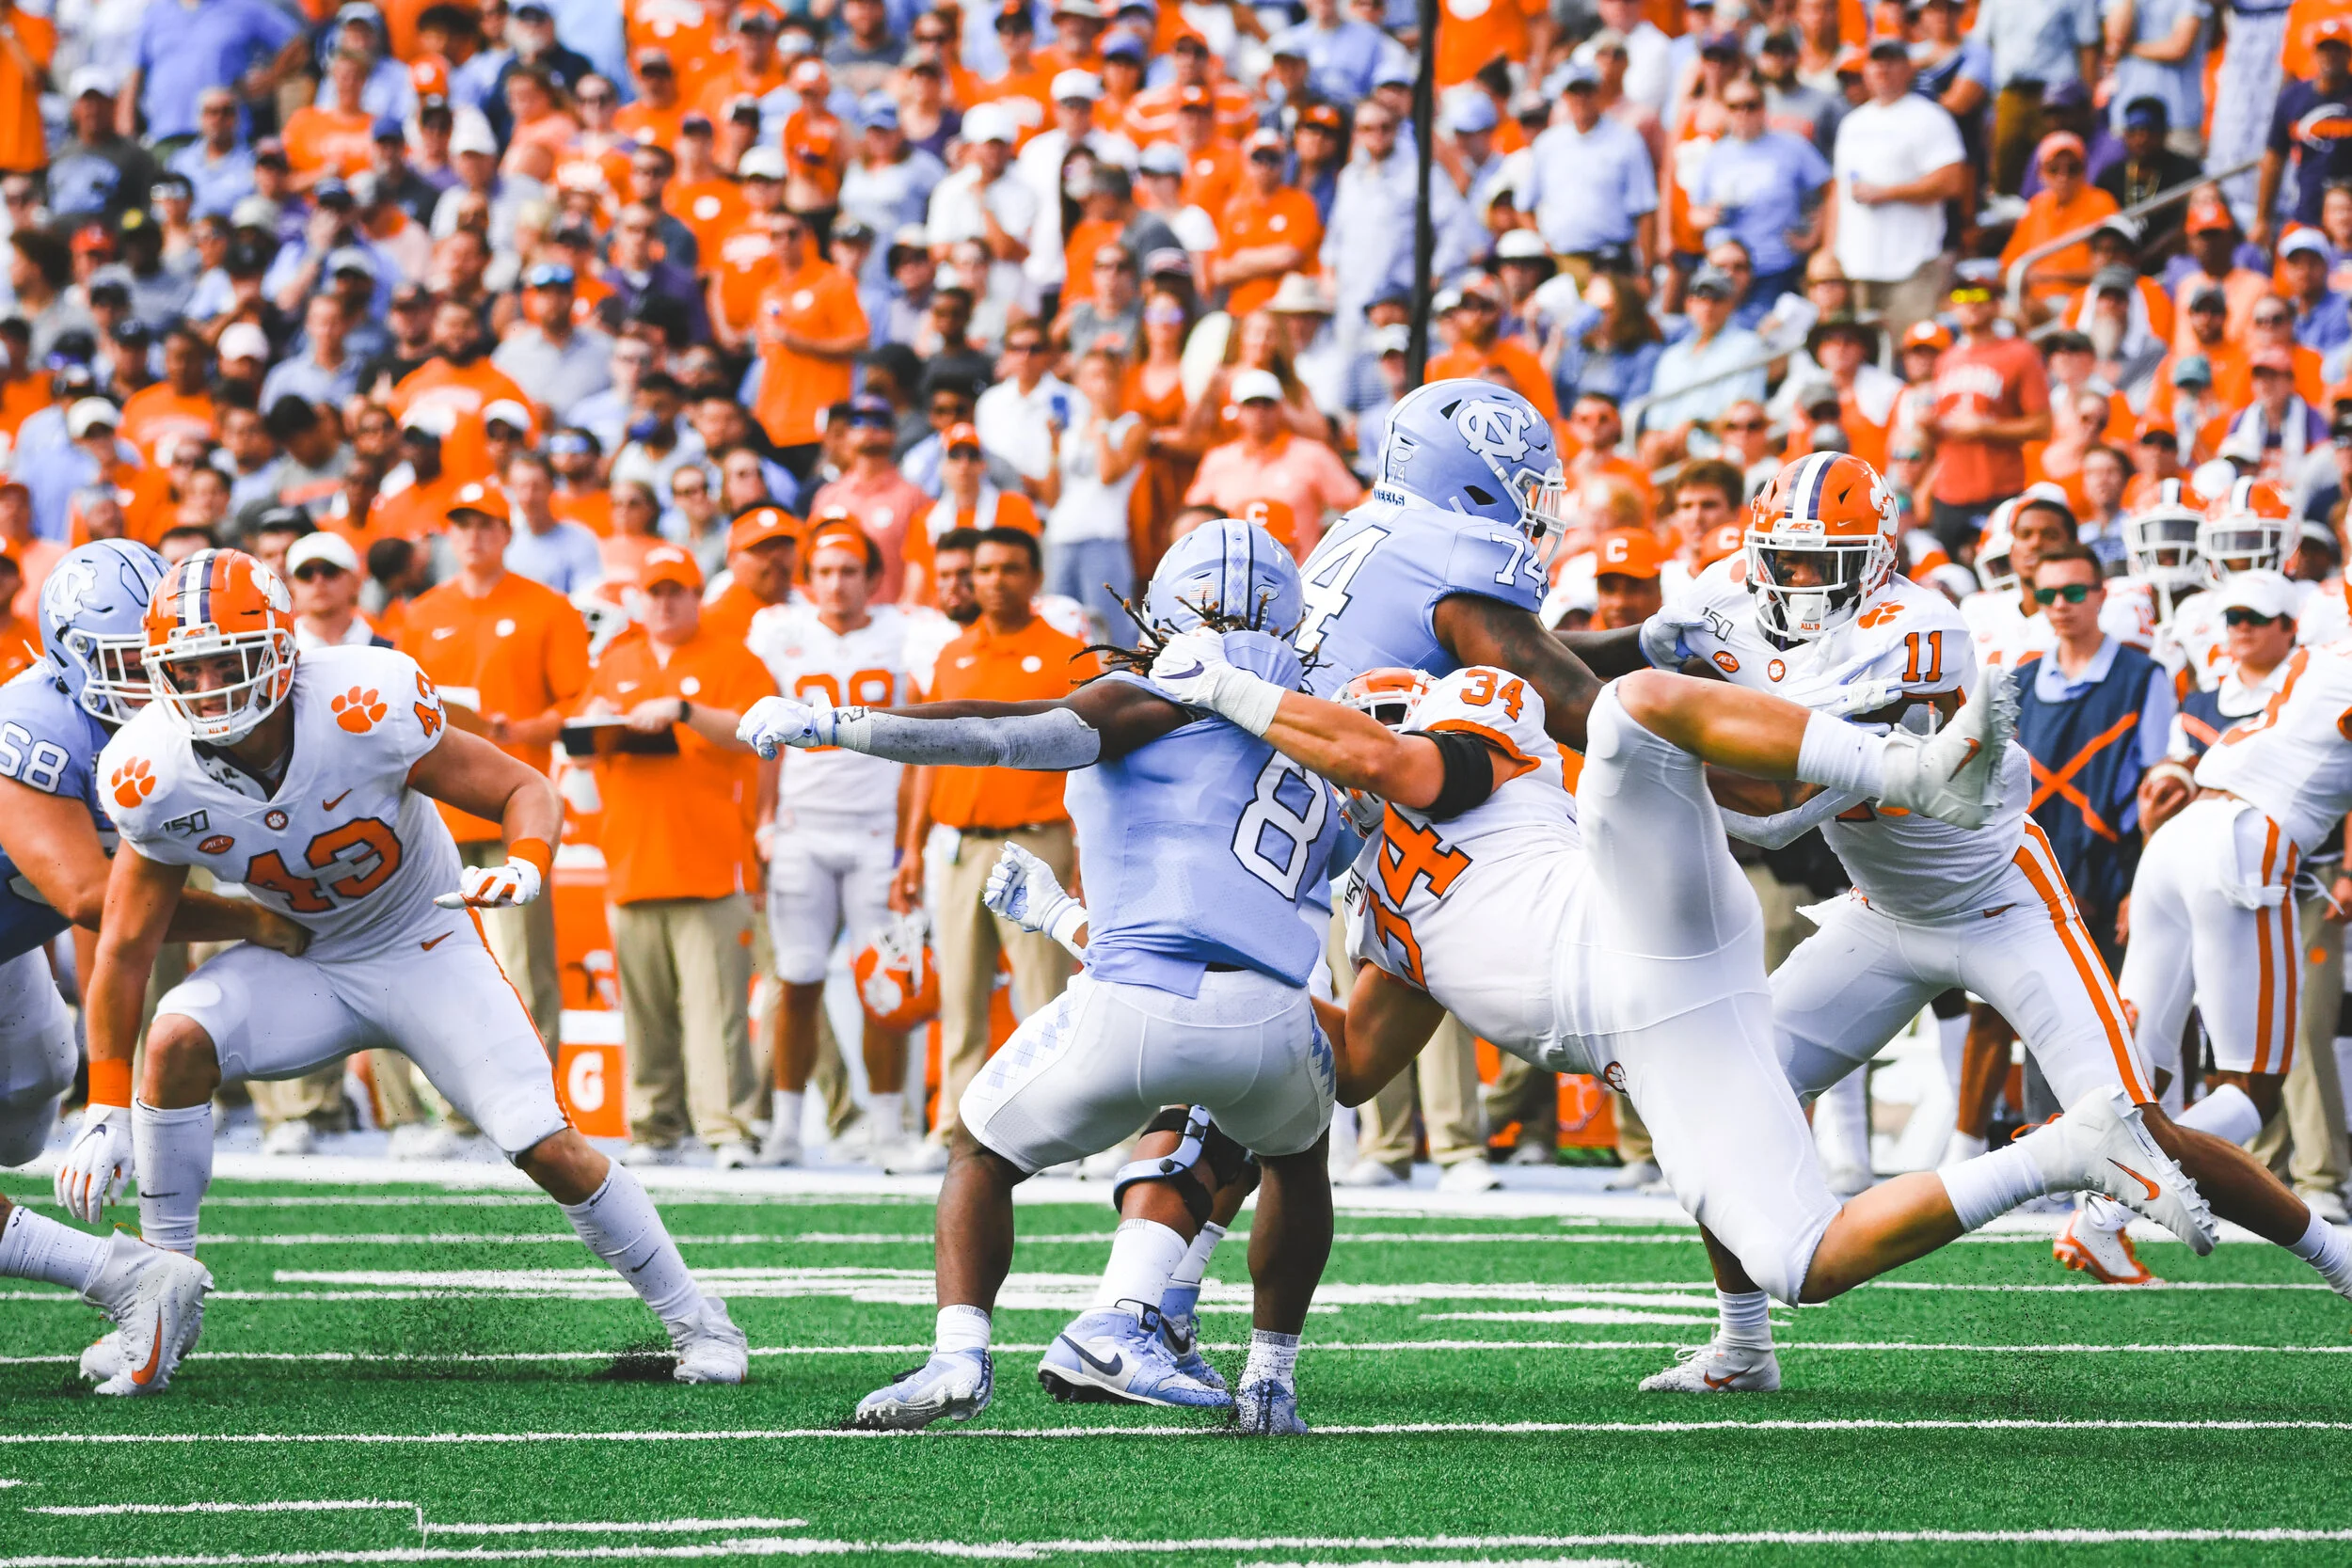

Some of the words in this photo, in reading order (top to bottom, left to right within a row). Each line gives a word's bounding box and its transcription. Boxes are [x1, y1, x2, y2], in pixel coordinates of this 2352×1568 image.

[1391, 463, 1406, 483] 74
[1606, 538, 1629, 562] C
[1718, 527, 1740, 549] C
[1490, 532, 1549, 601] 74
[1717, 655, 1735, 667] ACC
[1901, 630, 1943, 682] 11
[1459, 668, 1525, 723] 34
[0, 721, 71, 794] 68
[163, 809, 211, 838] 150
[1230, 749, 1328, 903] 8
[244, 816, 403, 913] 43
[567, 1051, 605, 1112] G
